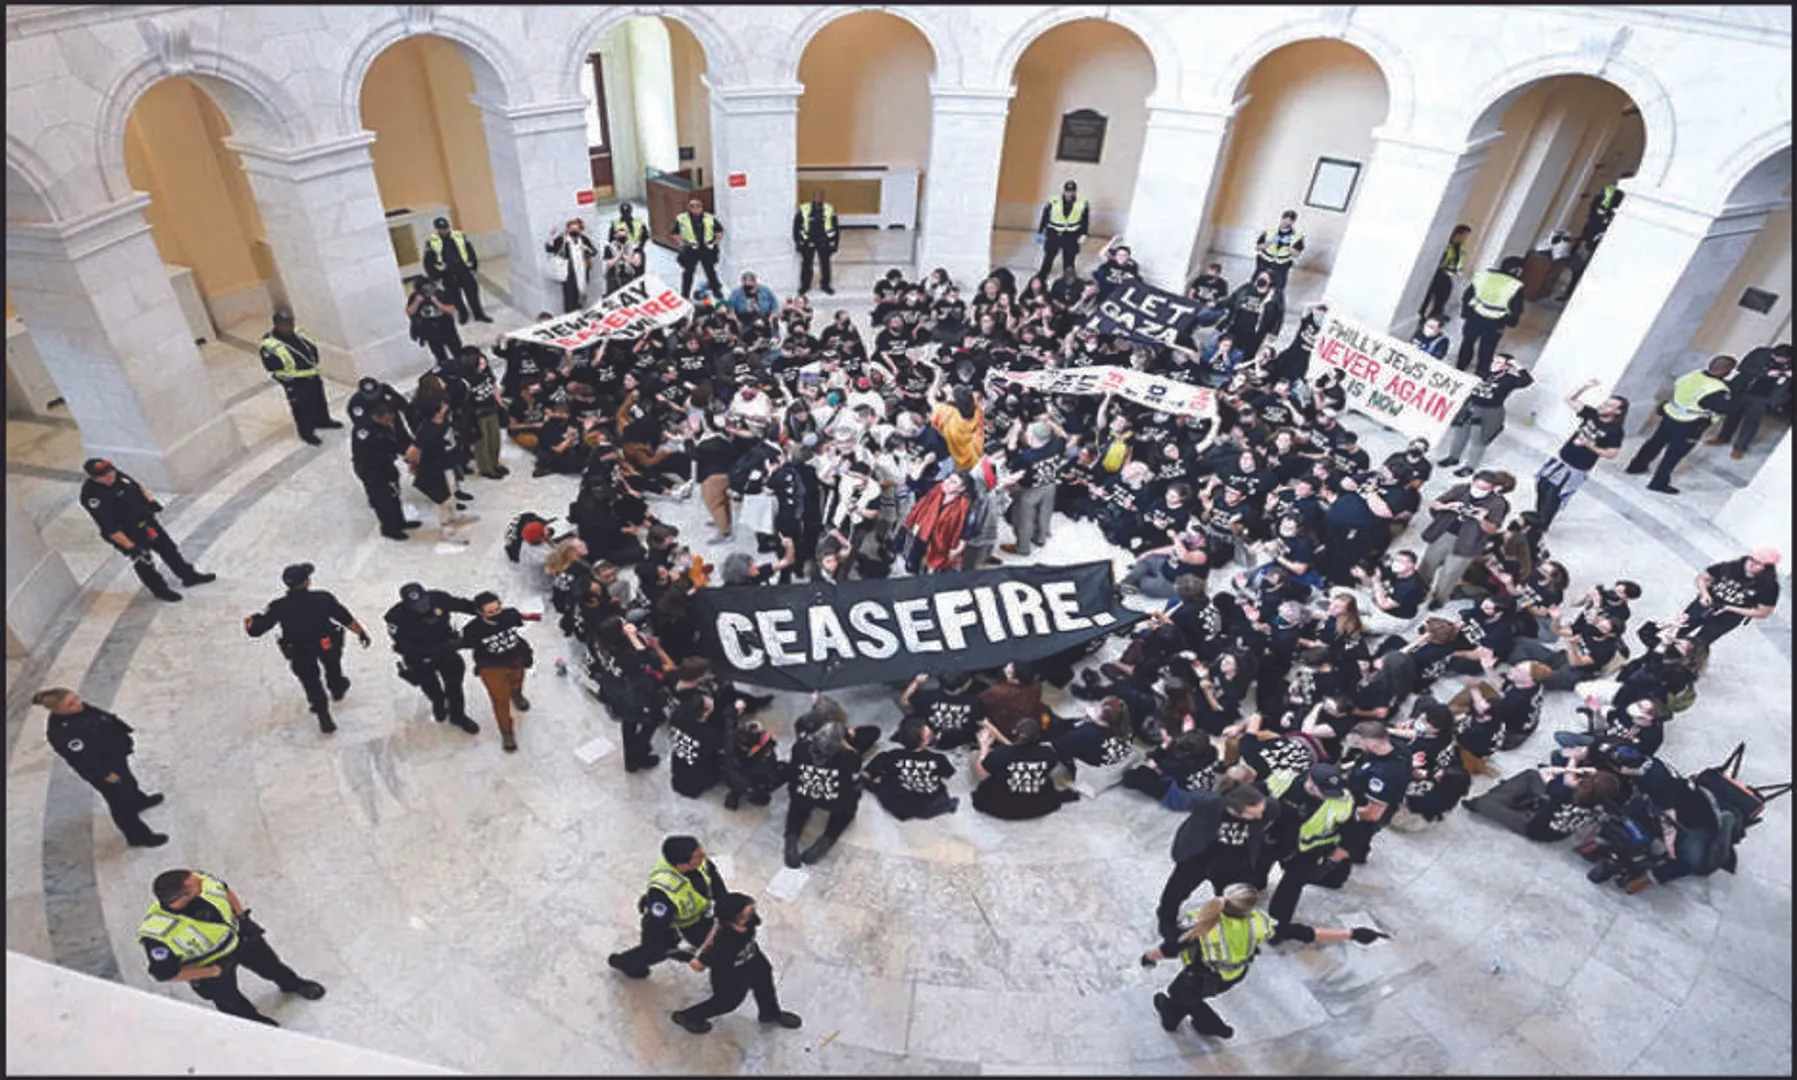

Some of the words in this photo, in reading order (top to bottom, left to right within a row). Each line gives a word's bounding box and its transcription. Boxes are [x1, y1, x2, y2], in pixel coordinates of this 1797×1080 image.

[1100, 300, 1179, 346] GAZA
[1120, 286, 1195, 324] LET
[1317, 336, 1381, 384] NEVER
[1384, 375, 1455, 423] AGAIN
[1328, 320, 1383, 354] PHILLY
[1383, 349, 1427, 379] JEWS
[1428, 371, 1464, 396] SAY
[1347, 379, 1365, 398] IS
[1368, 390, 1403, 416] NOW
[715, 581, 1117, 671] CEASEFIRE.
